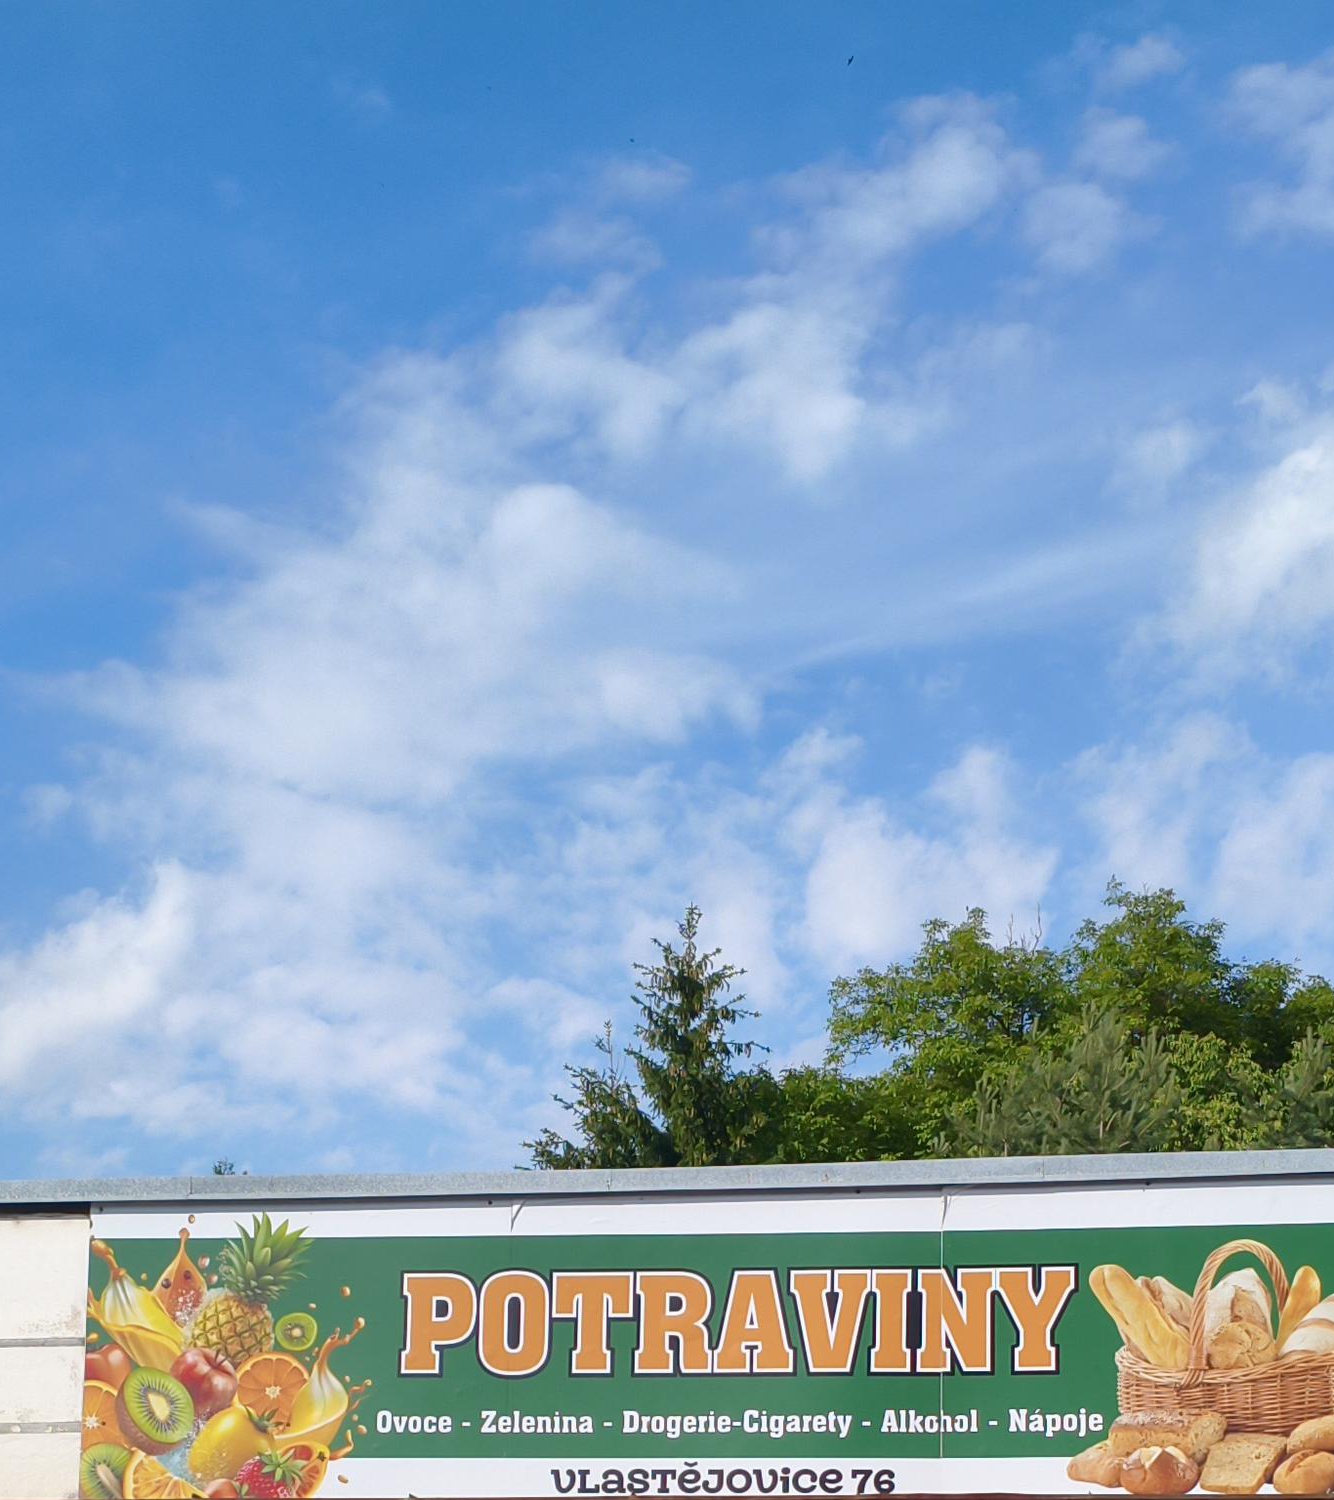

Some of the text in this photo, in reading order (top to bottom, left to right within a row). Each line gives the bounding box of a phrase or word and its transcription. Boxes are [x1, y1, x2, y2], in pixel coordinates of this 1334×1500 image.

[400, 1265, 1078, 1376] POTRAVINY
[376, 1410, 452, 1433] Ovoce
[480, 1410, 593, 1433] Zelenina
[881, 1409, 979, 1433] Alkohol
[1009, 1408, 1104, 1438] Nápoje
[851, 1468, 896, 1495] 76
